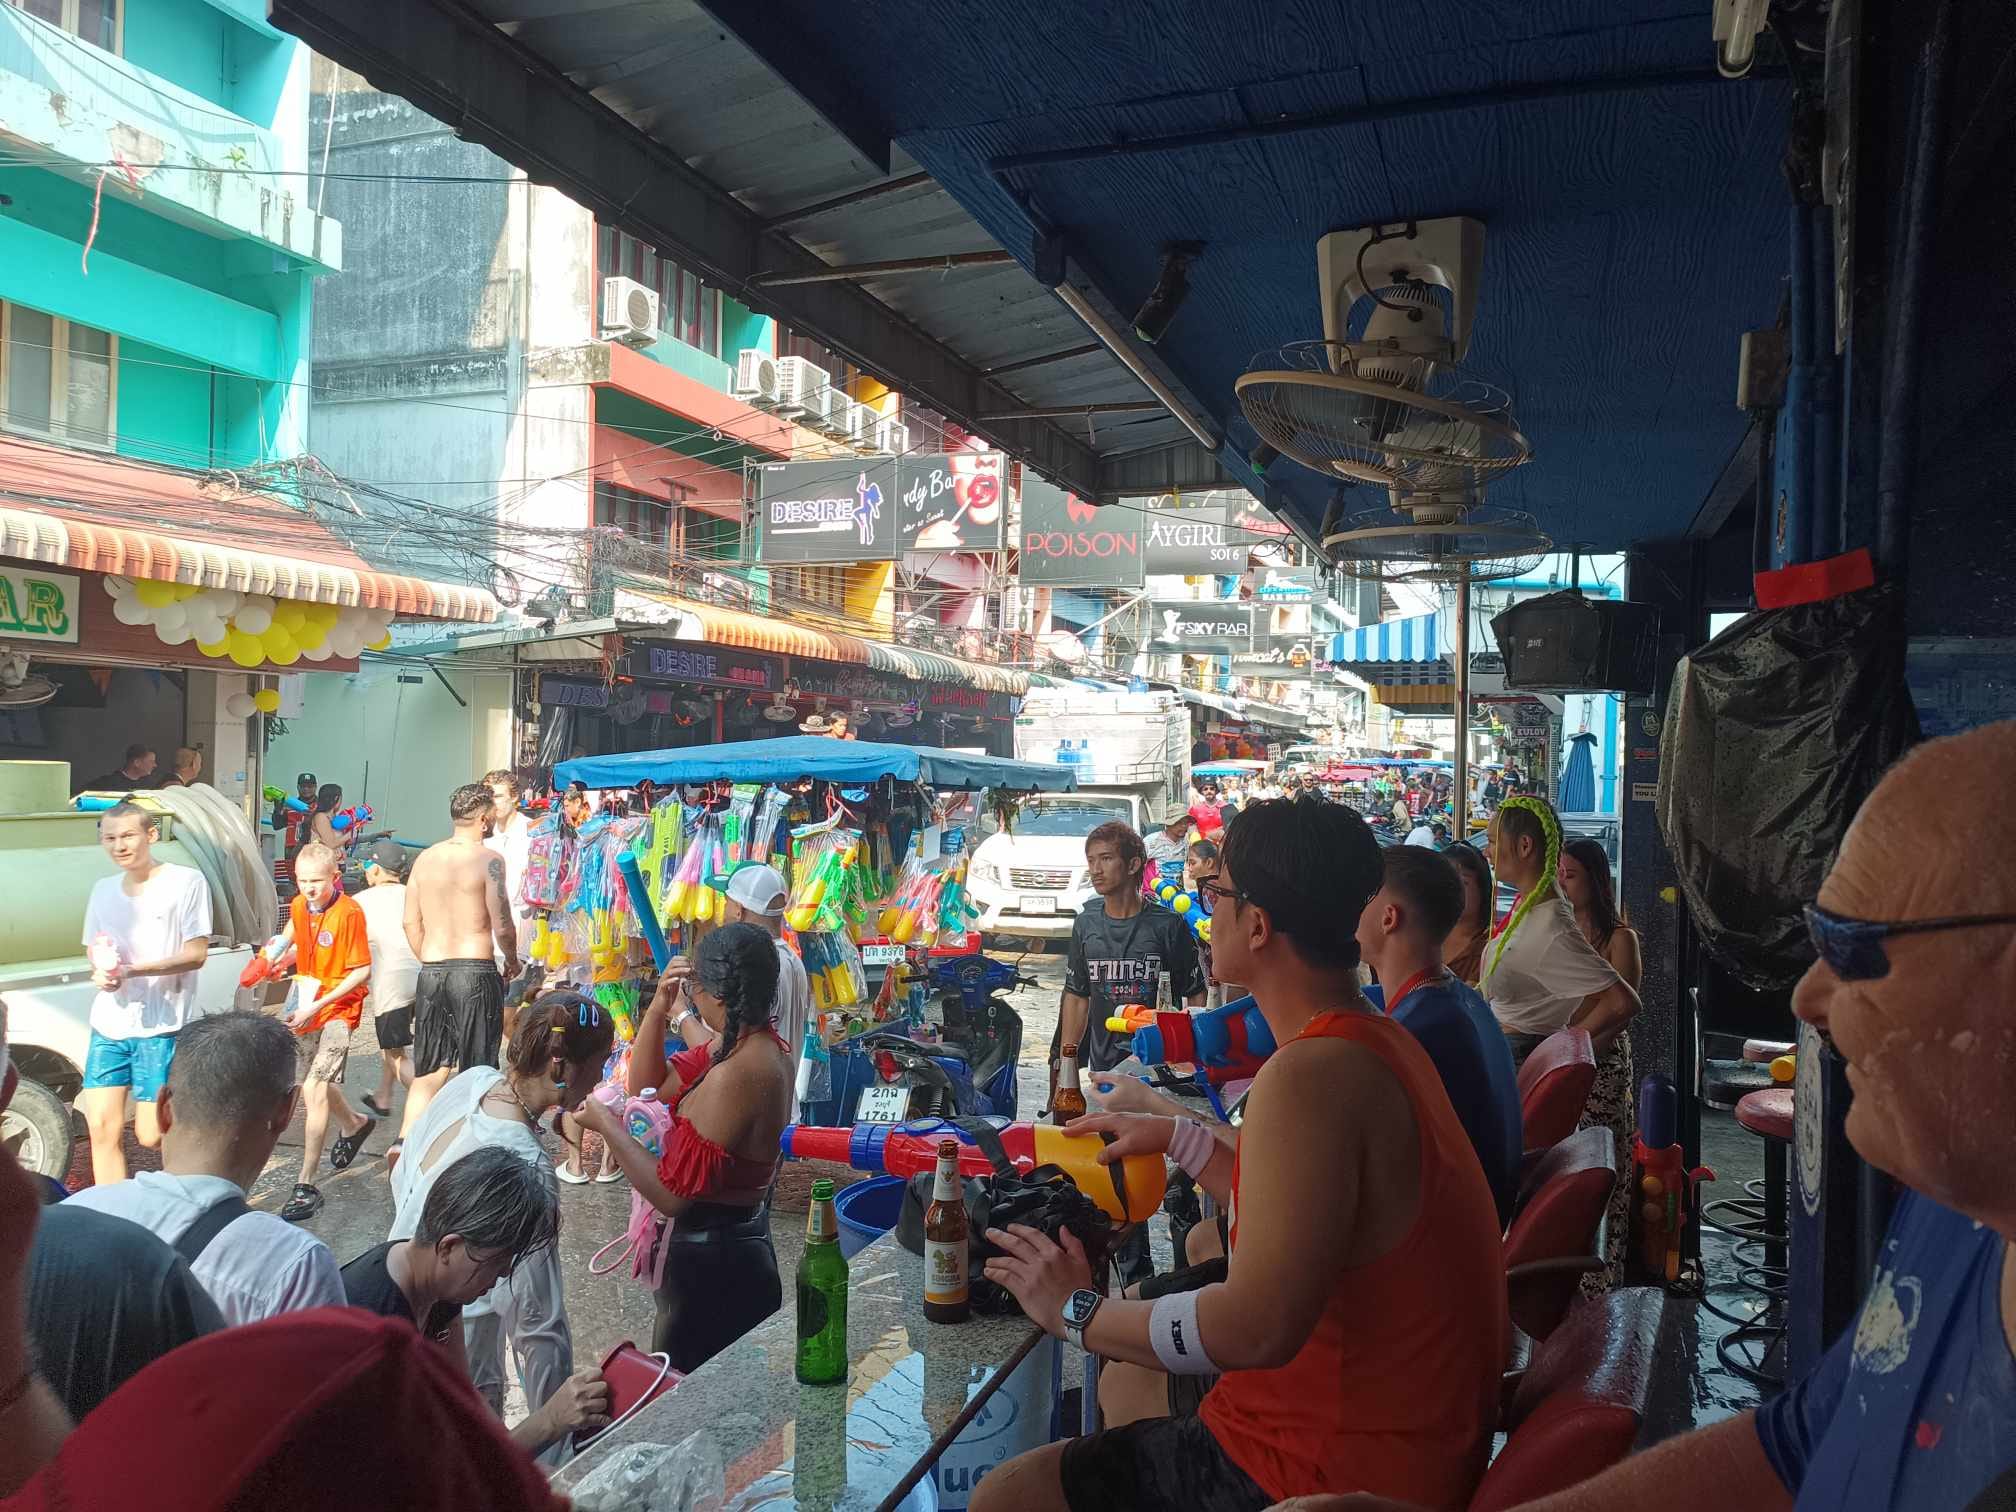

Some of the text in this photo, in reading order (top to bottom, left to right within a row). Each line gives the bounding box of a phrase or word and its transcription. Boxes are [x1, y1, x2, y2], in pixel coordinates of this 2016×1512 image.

[771, 499, 853, 523] DESIRE
[1026, 533, 1137, 557] POISON
[1210, 549, 1240, 560] SOI 6
[1217, 622, 1248, 635] BAR
[651, 648, 717, 678] DESIRE
[1516, 728, 1546, 736] KULOV
[864, 1111, 897, 1121] 1761
